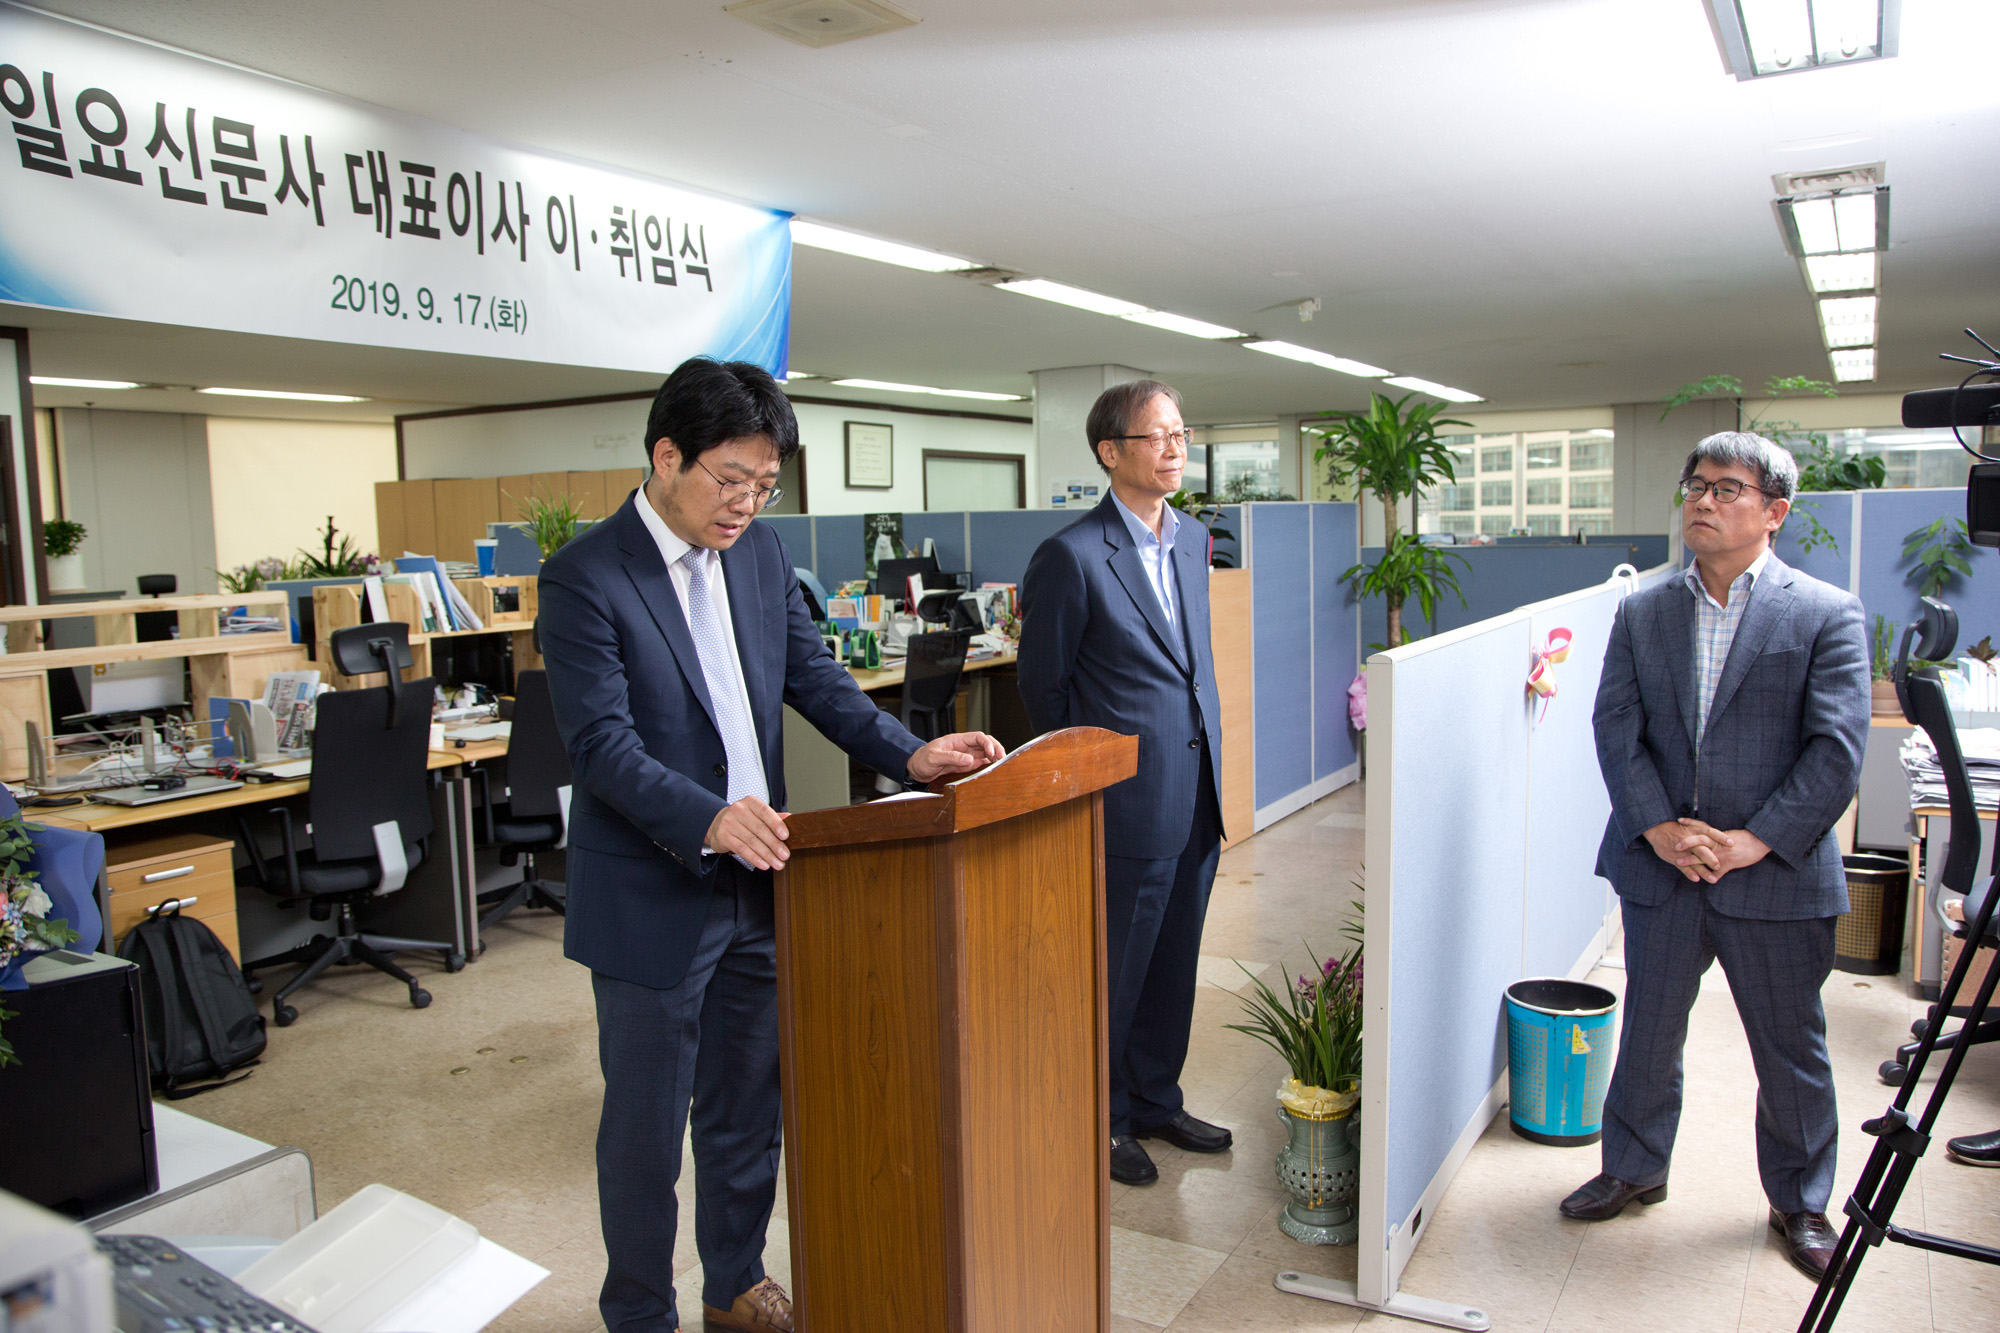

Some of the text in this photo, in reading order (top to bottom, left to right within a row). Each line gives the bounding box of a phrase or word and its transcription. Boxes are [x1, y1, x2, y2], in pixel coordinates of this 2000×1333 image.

[0, 63, 713, 293] 일요신문사 대표이사 이·취임식
[331, 274, 528, 335] 2019. 9. 17.(화)
